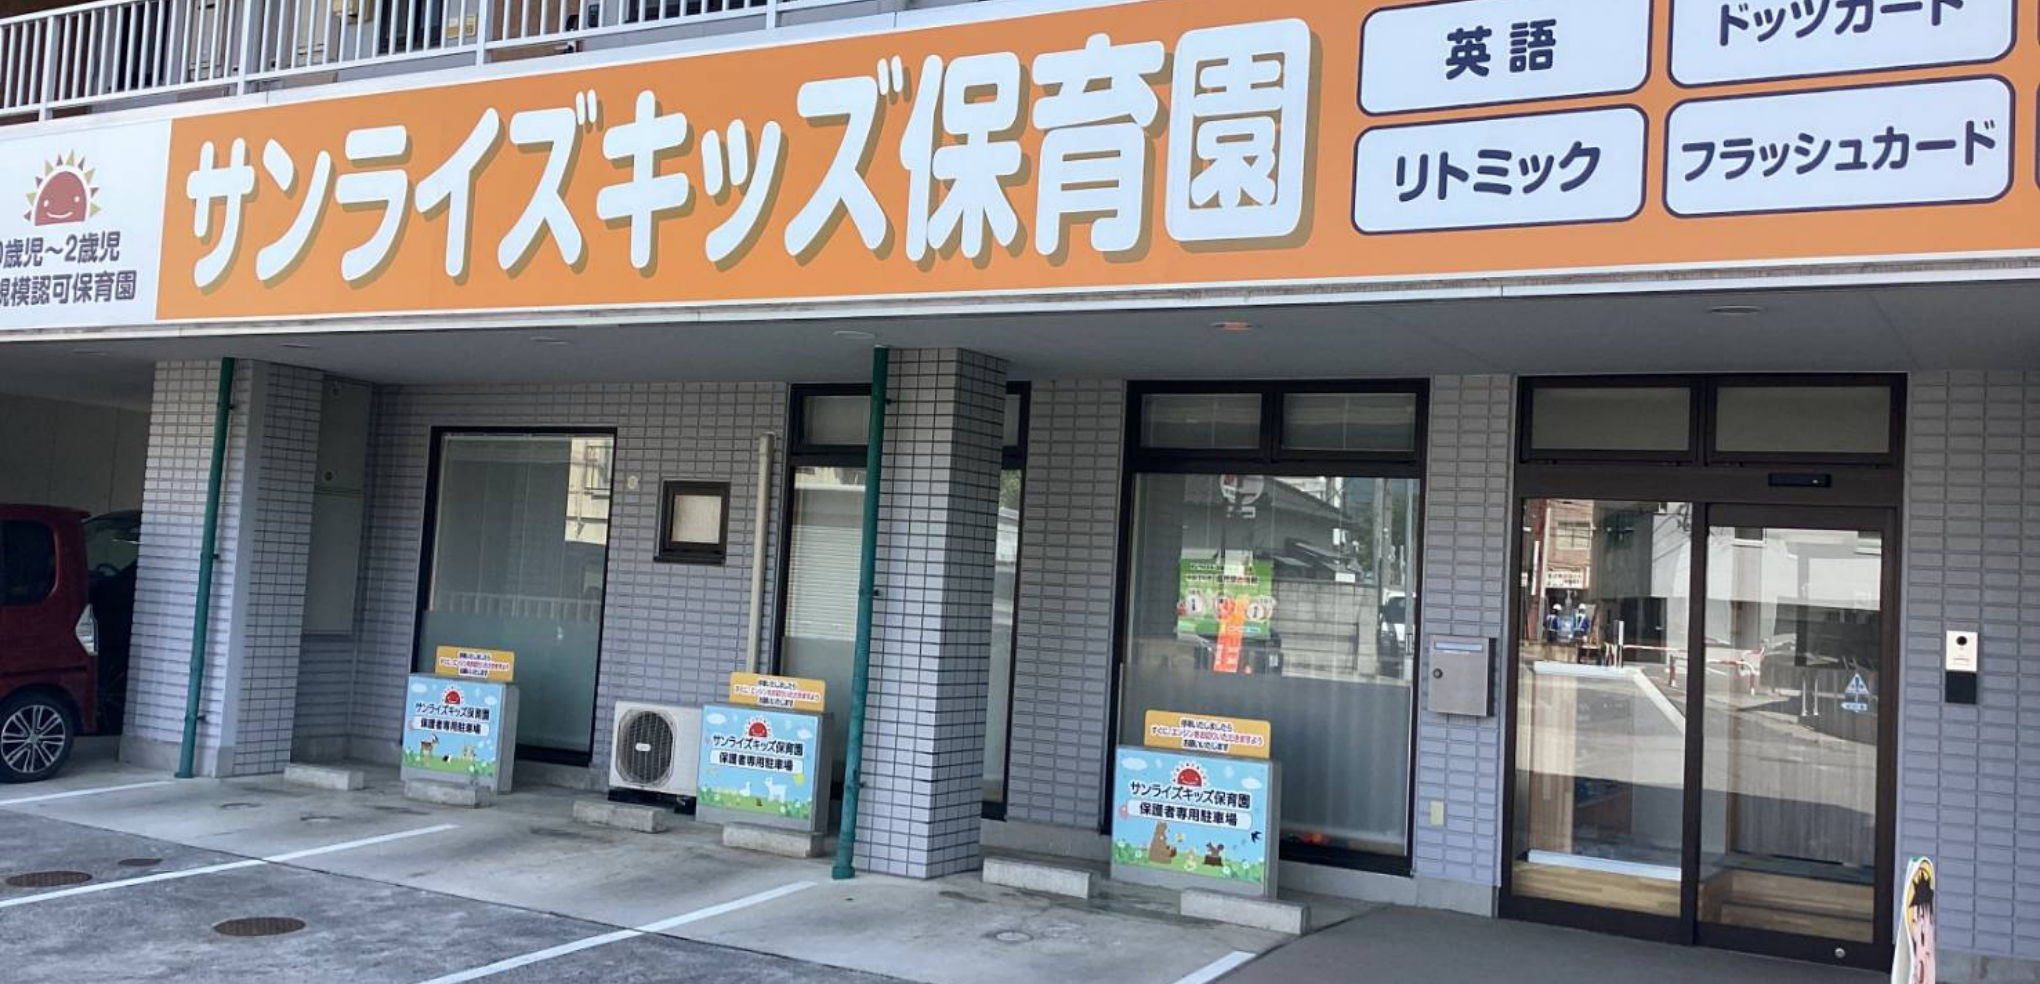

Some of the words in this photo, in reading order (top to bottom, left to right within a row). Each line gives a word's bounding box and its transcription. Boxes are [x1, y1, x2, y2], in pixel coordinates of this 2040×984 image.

[1445, 18, 1557, 80] 英語
[186, 18, 1312, 288] サンライズキッズ保育園
[1395, 140, 1601, 203] リトミック
[1682, 120, 1996, 182] フラッシュカード
[1130, 781, 1251, 809] サンライズキッズ保育園
[1139, 801, 1238, 827] 保護者専用駐車場
